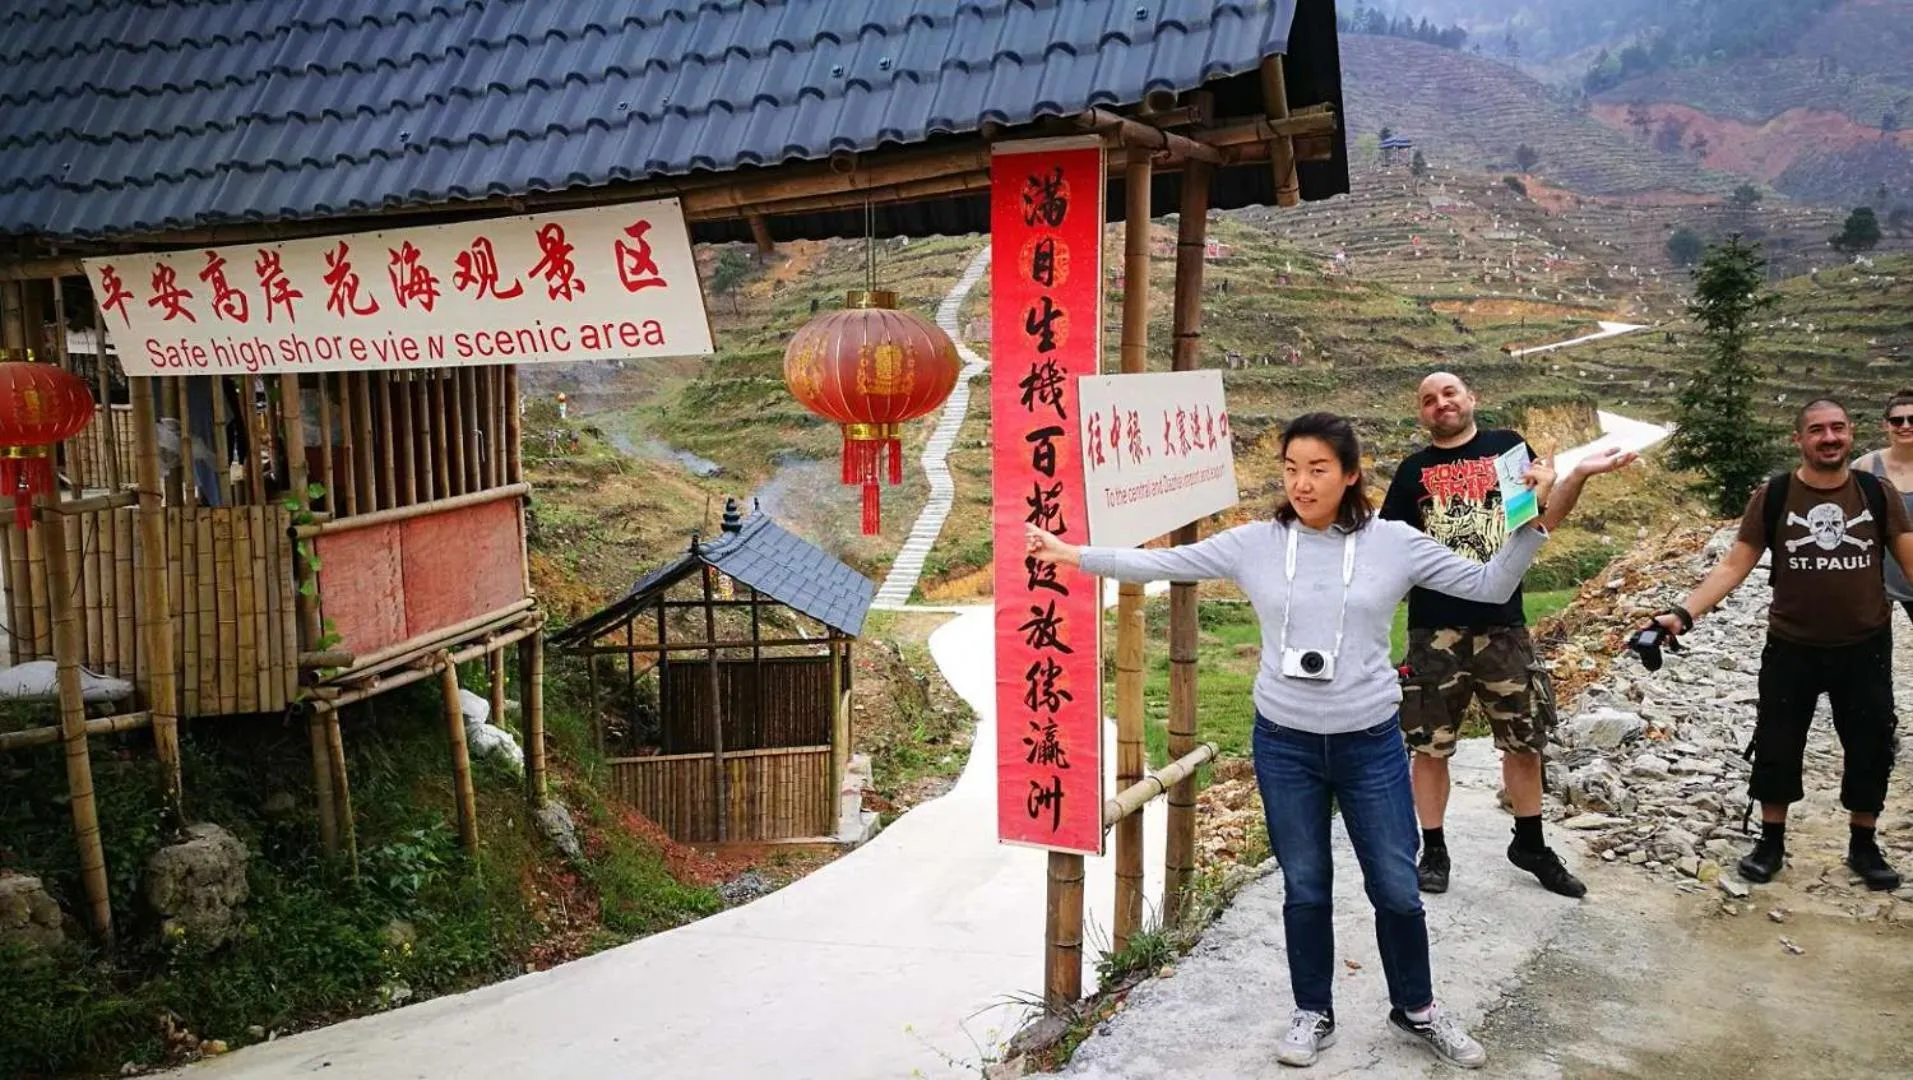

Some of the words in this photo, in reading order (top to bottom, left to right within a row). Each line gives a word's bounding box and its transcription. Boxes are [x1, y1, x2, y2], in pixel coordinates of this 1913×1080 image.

[99, 219, 668, 329] 平安高岸花海观景区
[145, 337, 208, 368] Safe
[211, 335, 276, 372] high
[279, 333, 367, 363] shore
[455, 320, 571, 358] scenic
[579, 318, 665, 350] area
[1789, 556, 1812, 570] ST.
